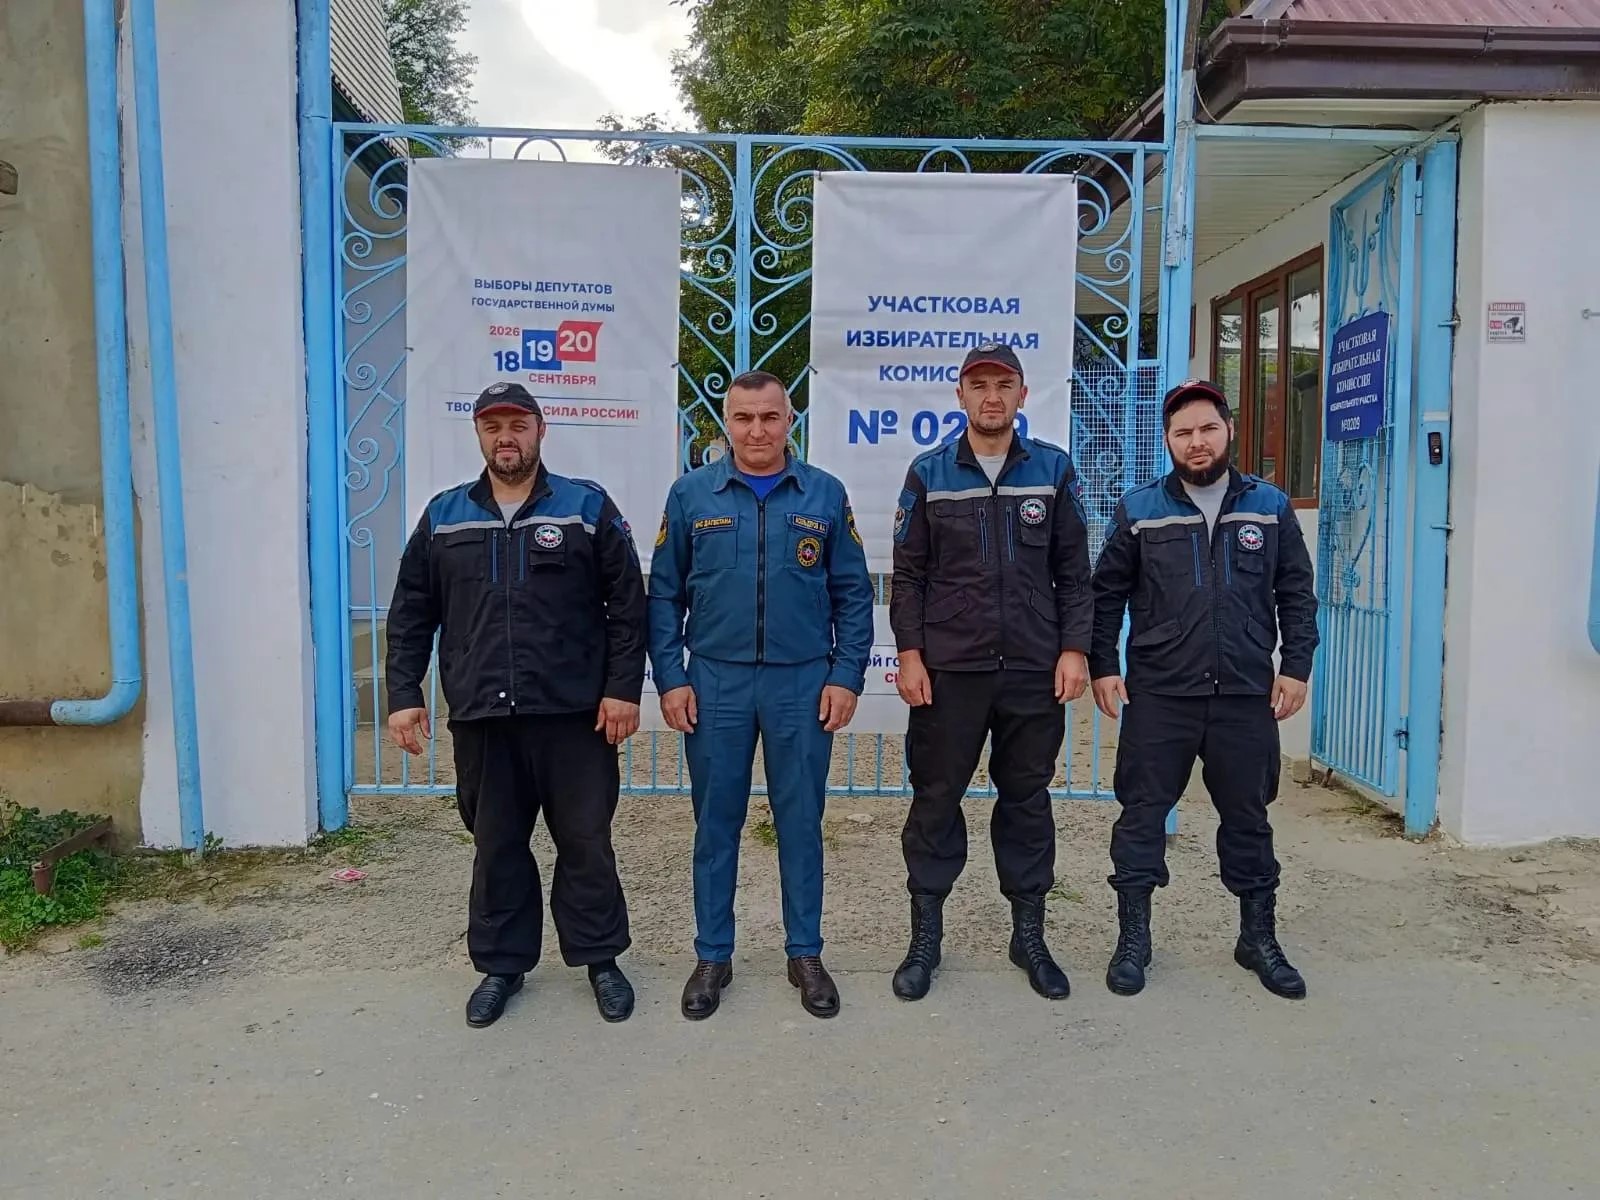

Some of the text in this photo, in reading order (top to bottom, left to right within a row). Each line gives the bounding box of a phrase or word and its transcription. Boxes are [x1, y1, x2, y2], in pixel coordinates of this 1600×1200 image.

[474, 278, 613, 295] ВЫБОРЫ ДЕПУТАТОВ
[471, 297, 615, 312] ГОСУДАРСТВЕННОЙ ДУМЫ
[867, 295, 1020, 315] УЧАСТКОВАЯ
[489, 325, 520, 337] 2026
[846, 330, 1039, 349] ИЗБИРАТЕЛЬНАЯ
[493, 330, 593, 372] 18 19 20
[1337, 328, 1377, 355] УЧАСТКОВАЯ
[528, 373, 596, 385] СЕНТЯБРЯ
[879, 365, 959, 382] КОМИС
[446, 401, 639, 420] ТВО СИЛА РОССИИ!
[848, 409, 898, 445] №
